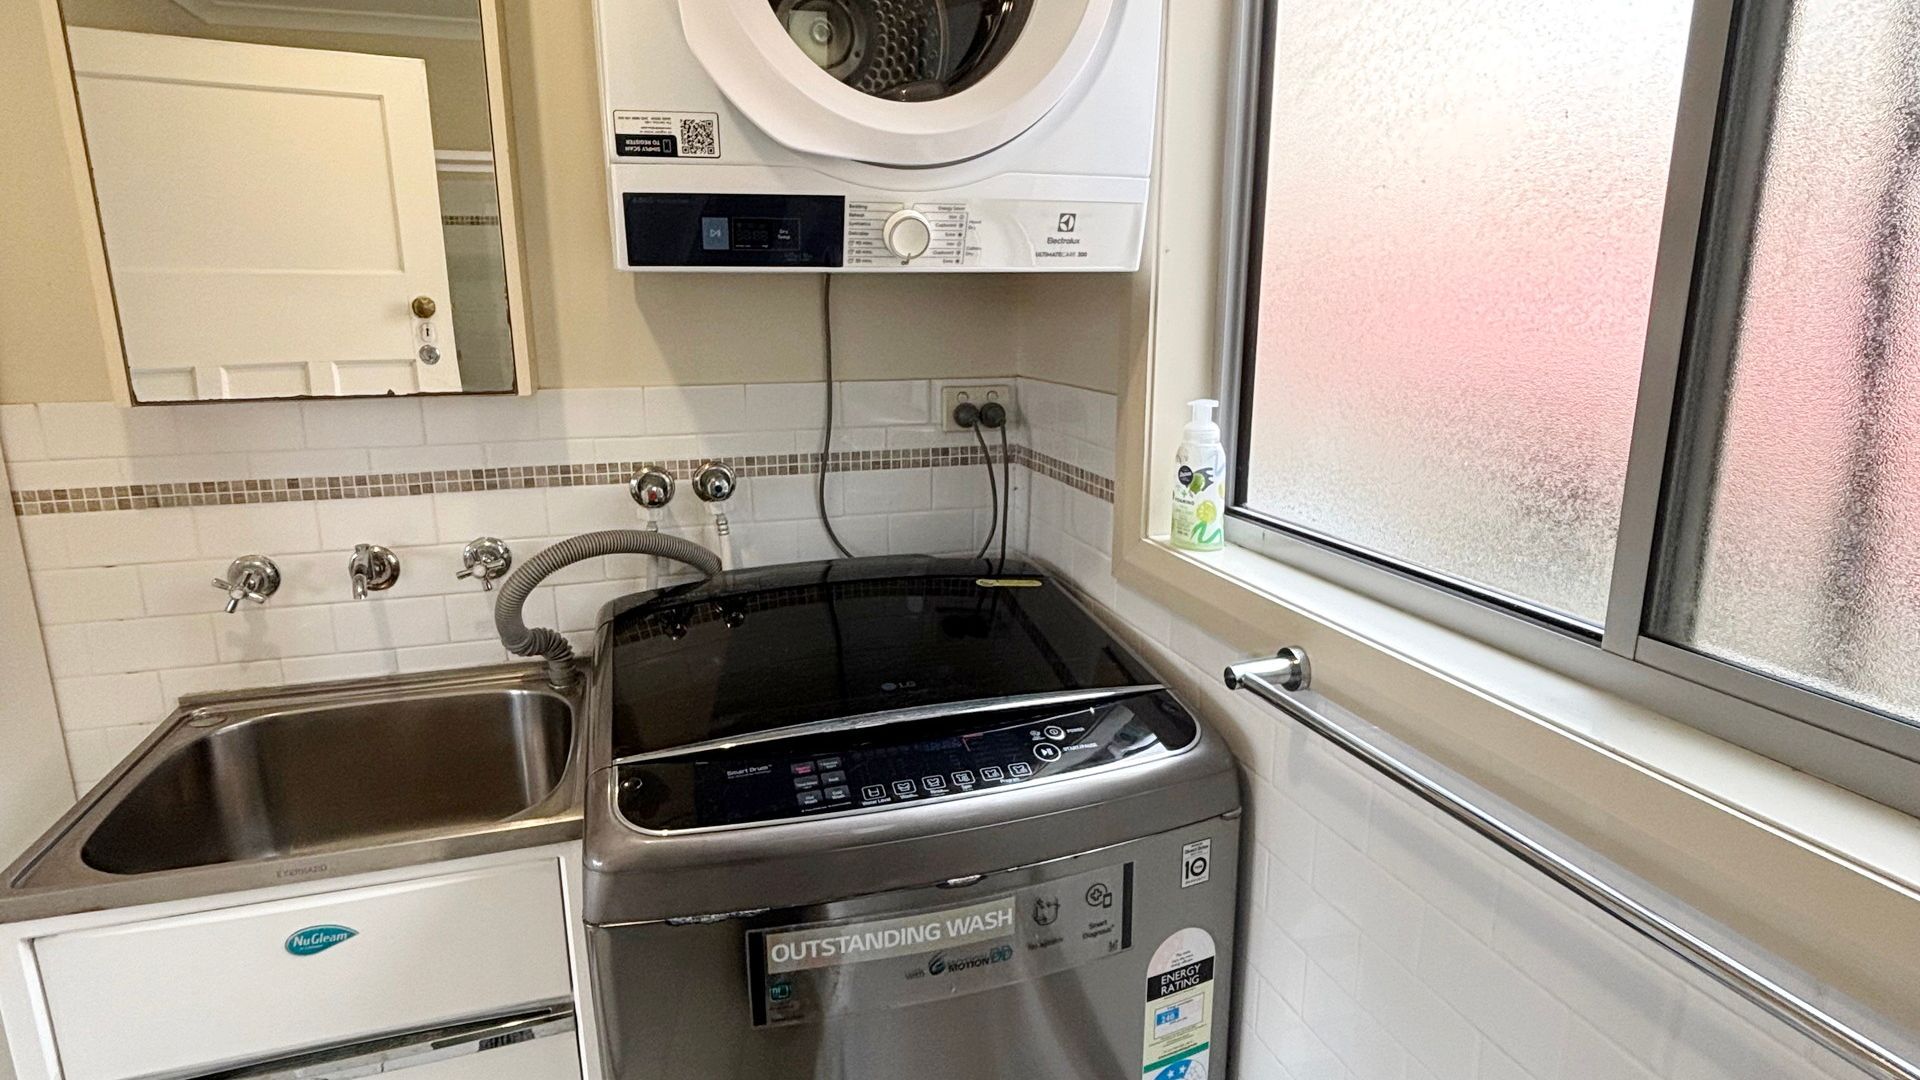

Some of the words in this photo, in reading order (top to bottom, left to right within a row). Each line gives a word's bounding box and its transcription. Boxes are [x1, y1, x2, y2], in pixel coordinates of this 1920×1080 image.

[625, 138, 651, 146] REGISTER
[652, 138, 661, 146] TO
[624, 145, 641, 153] SCAN
[642, 145, 661, 153] SIMPLY
[1047, 236, 1080, 244] Electrolux
[898, 680, 917, 689] LG
[726, 768, 749, 777] Smart
[1185, 857, 1207, 880] 10
[292, 932, 348, 947] NuGleam
[771, 922, 941, 963] OUTSTANDING
[946, 908, 1013, 937] WASH
[948, 957, 990, 973] MOTION
[1161, 963, 1202, 985] ENERGY
[1161, 974, 1200, 996] RATING
